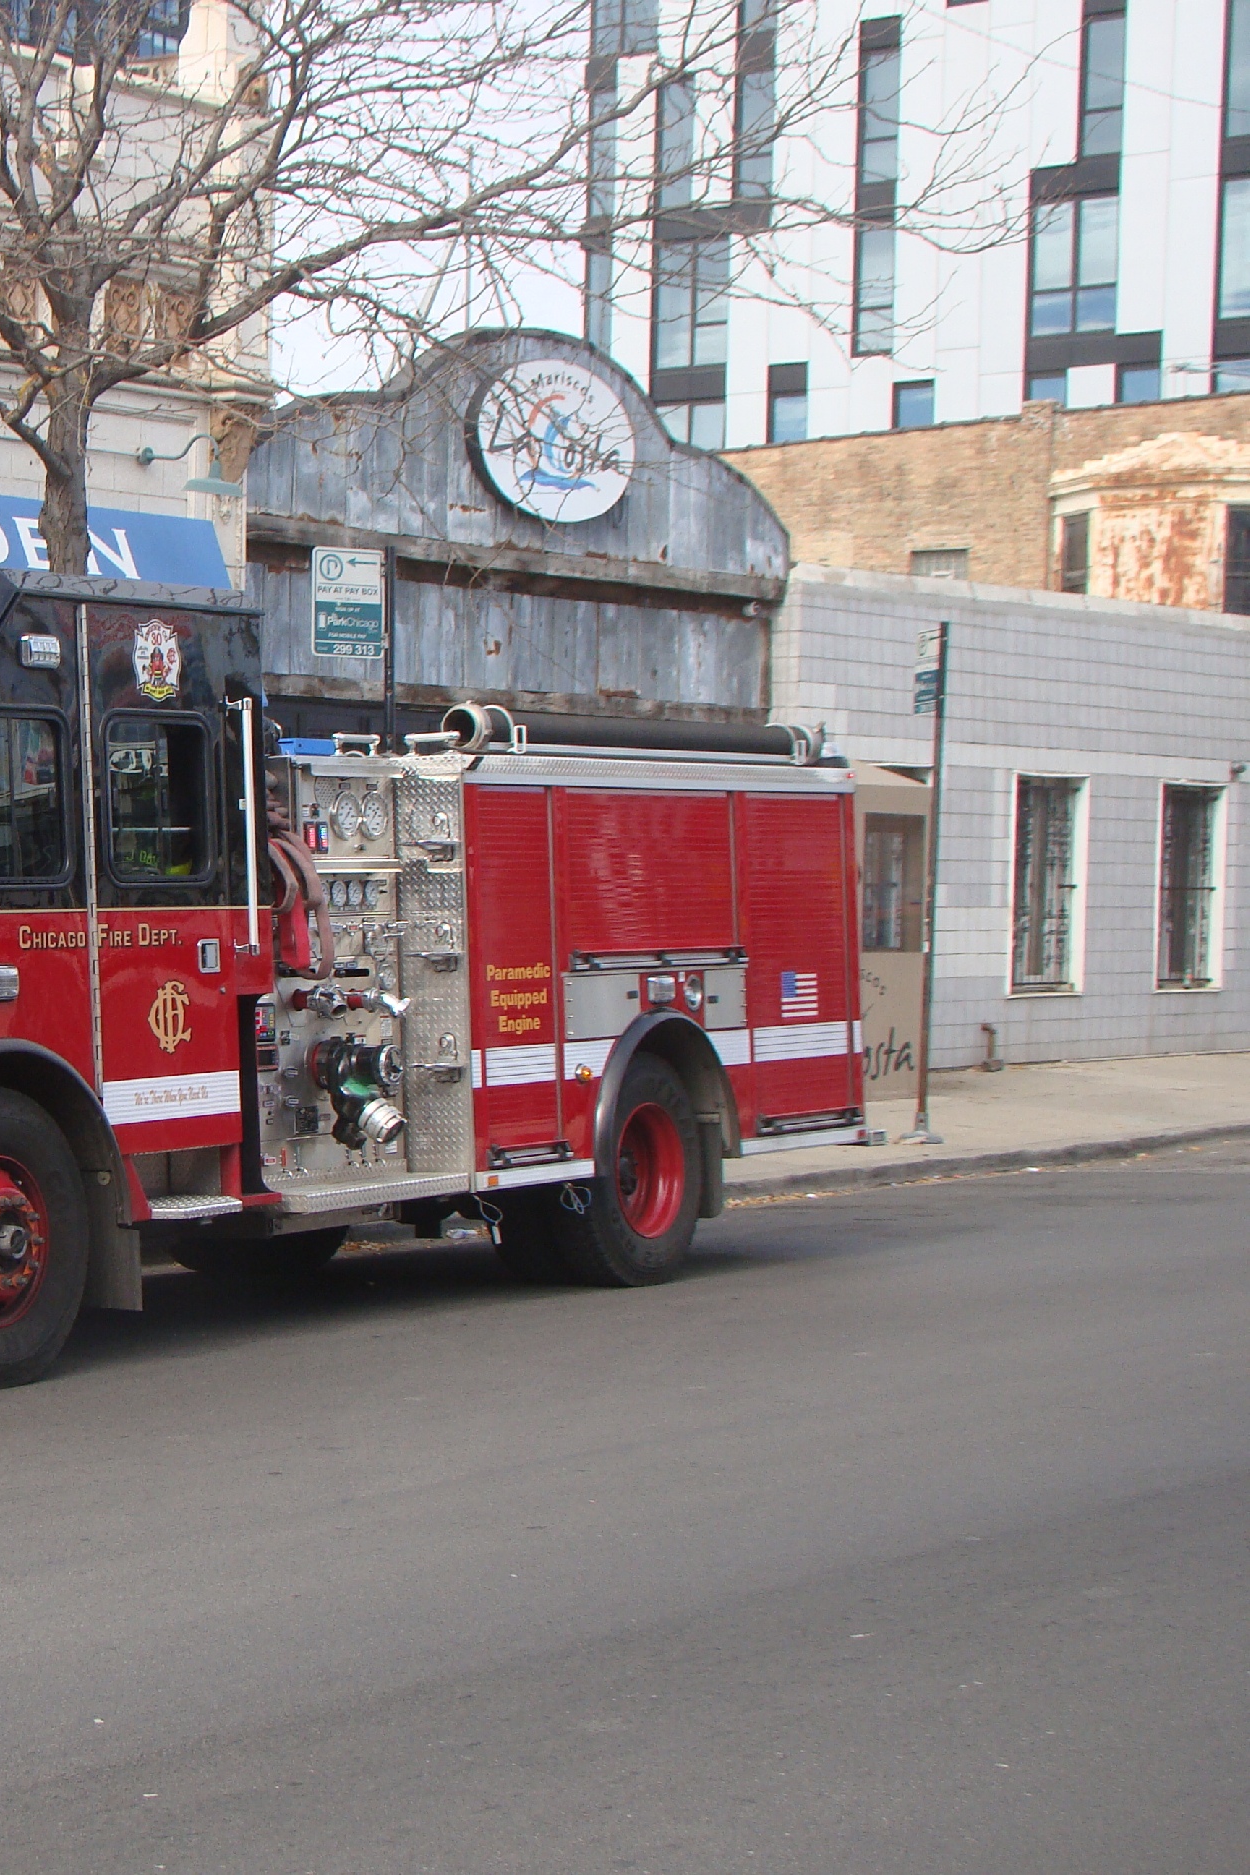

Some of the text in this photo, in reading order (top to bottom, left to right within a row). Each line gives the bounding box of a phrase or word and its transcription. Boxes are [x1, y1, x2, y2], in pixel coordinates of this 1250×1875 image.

[317, 585, 379, 596] PAY AT PAY BOX
[333, 643, 353, 655] 299
[355, 644, 375, 656] 313
[486, 962, 551, 981] Paramedic
[490, 987, 548, 1011] Equipped
[498, 1014, 541, 1035] Engine
